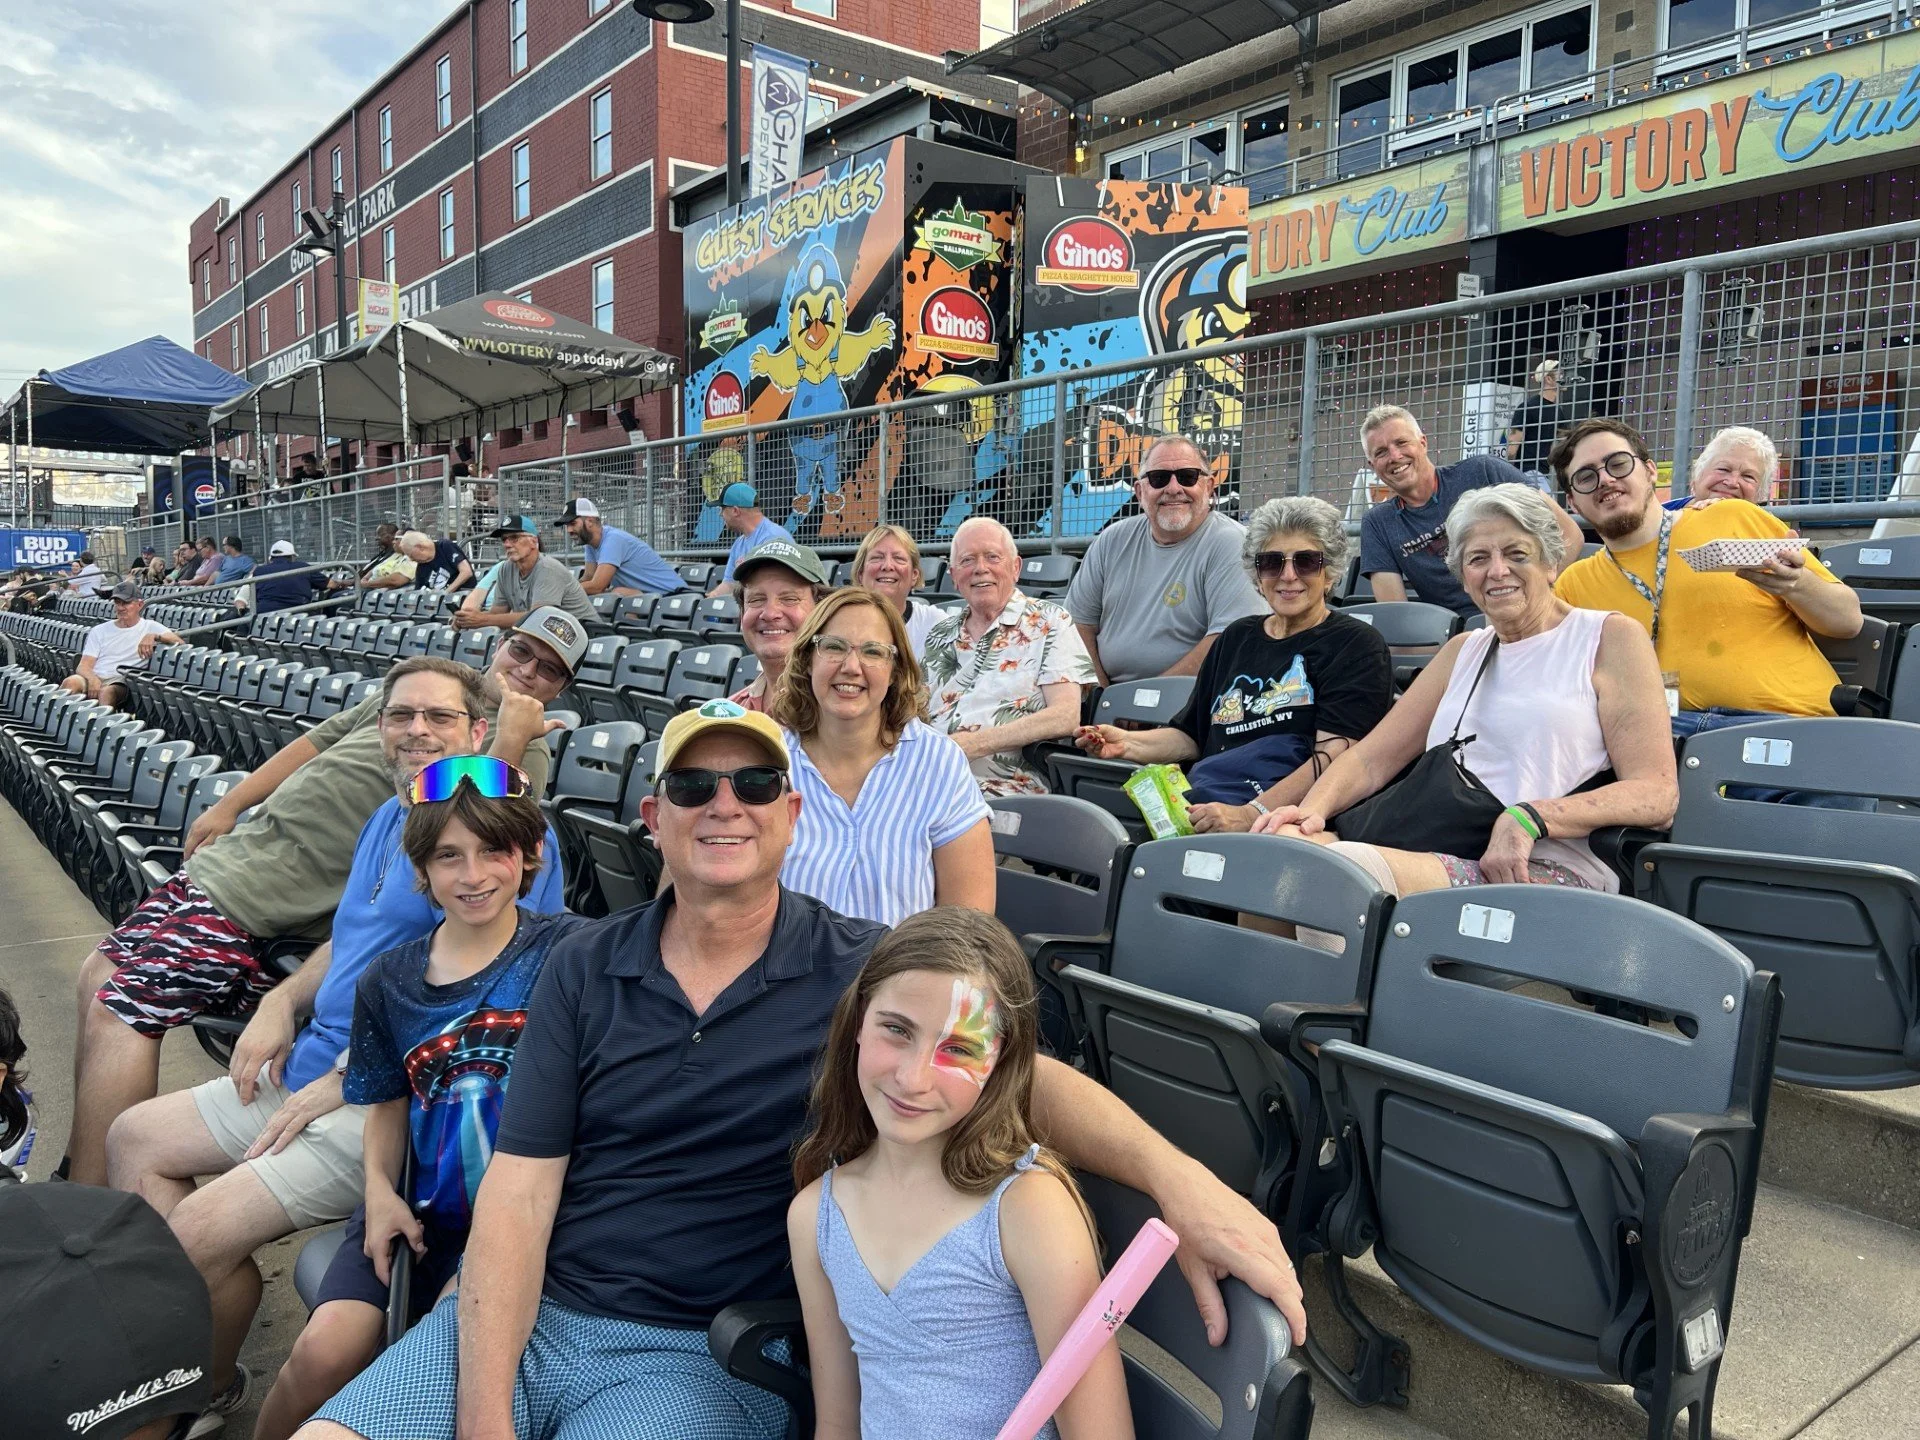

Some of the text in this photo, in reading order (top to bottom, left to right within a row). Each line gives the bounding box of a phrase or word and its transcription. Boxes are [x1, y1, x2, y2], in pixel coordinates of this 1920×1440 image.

[772, 109, 797, 186] GHA
[1519, 62, 1920, 219] VICTORY Club
[697, 162, 885, 270] GUEST SERVICES
[1339, 182, 1449, 256] Club
[932, 226, 983, 244] gomart
[943, 244, 975, 257] BALLPARK
[1055, 233, 1124, 269] Gino's
[1042, 271, 1136, 284] PIZZA & SPAGHETTI HOUSE
[482, 321, 587, 339] wvlottery.com
[708, 316, 737, 336] gomart
[930, 301, 987, 341] Gino's
[462, 336, 554, 360] WVLOTTERY
[556, 351, 581, 365] app
[582, 352, 625, 370] today!
[920, 338, 938, 348] PIZZA
[942, 341, 976, 353] SPAGHETTI
[709, 388, 741, 417] Gino's
[15, 549, 78, 565] LIGHT
[23, 536, 69, 551] BUD
[1275, 711, 1293, 722] WV
[1762, 739, 1772, 764] 1
[1482, 908, 1493, 938] 1
[66, 1366, 203, 1431] Mitchell & Ness
